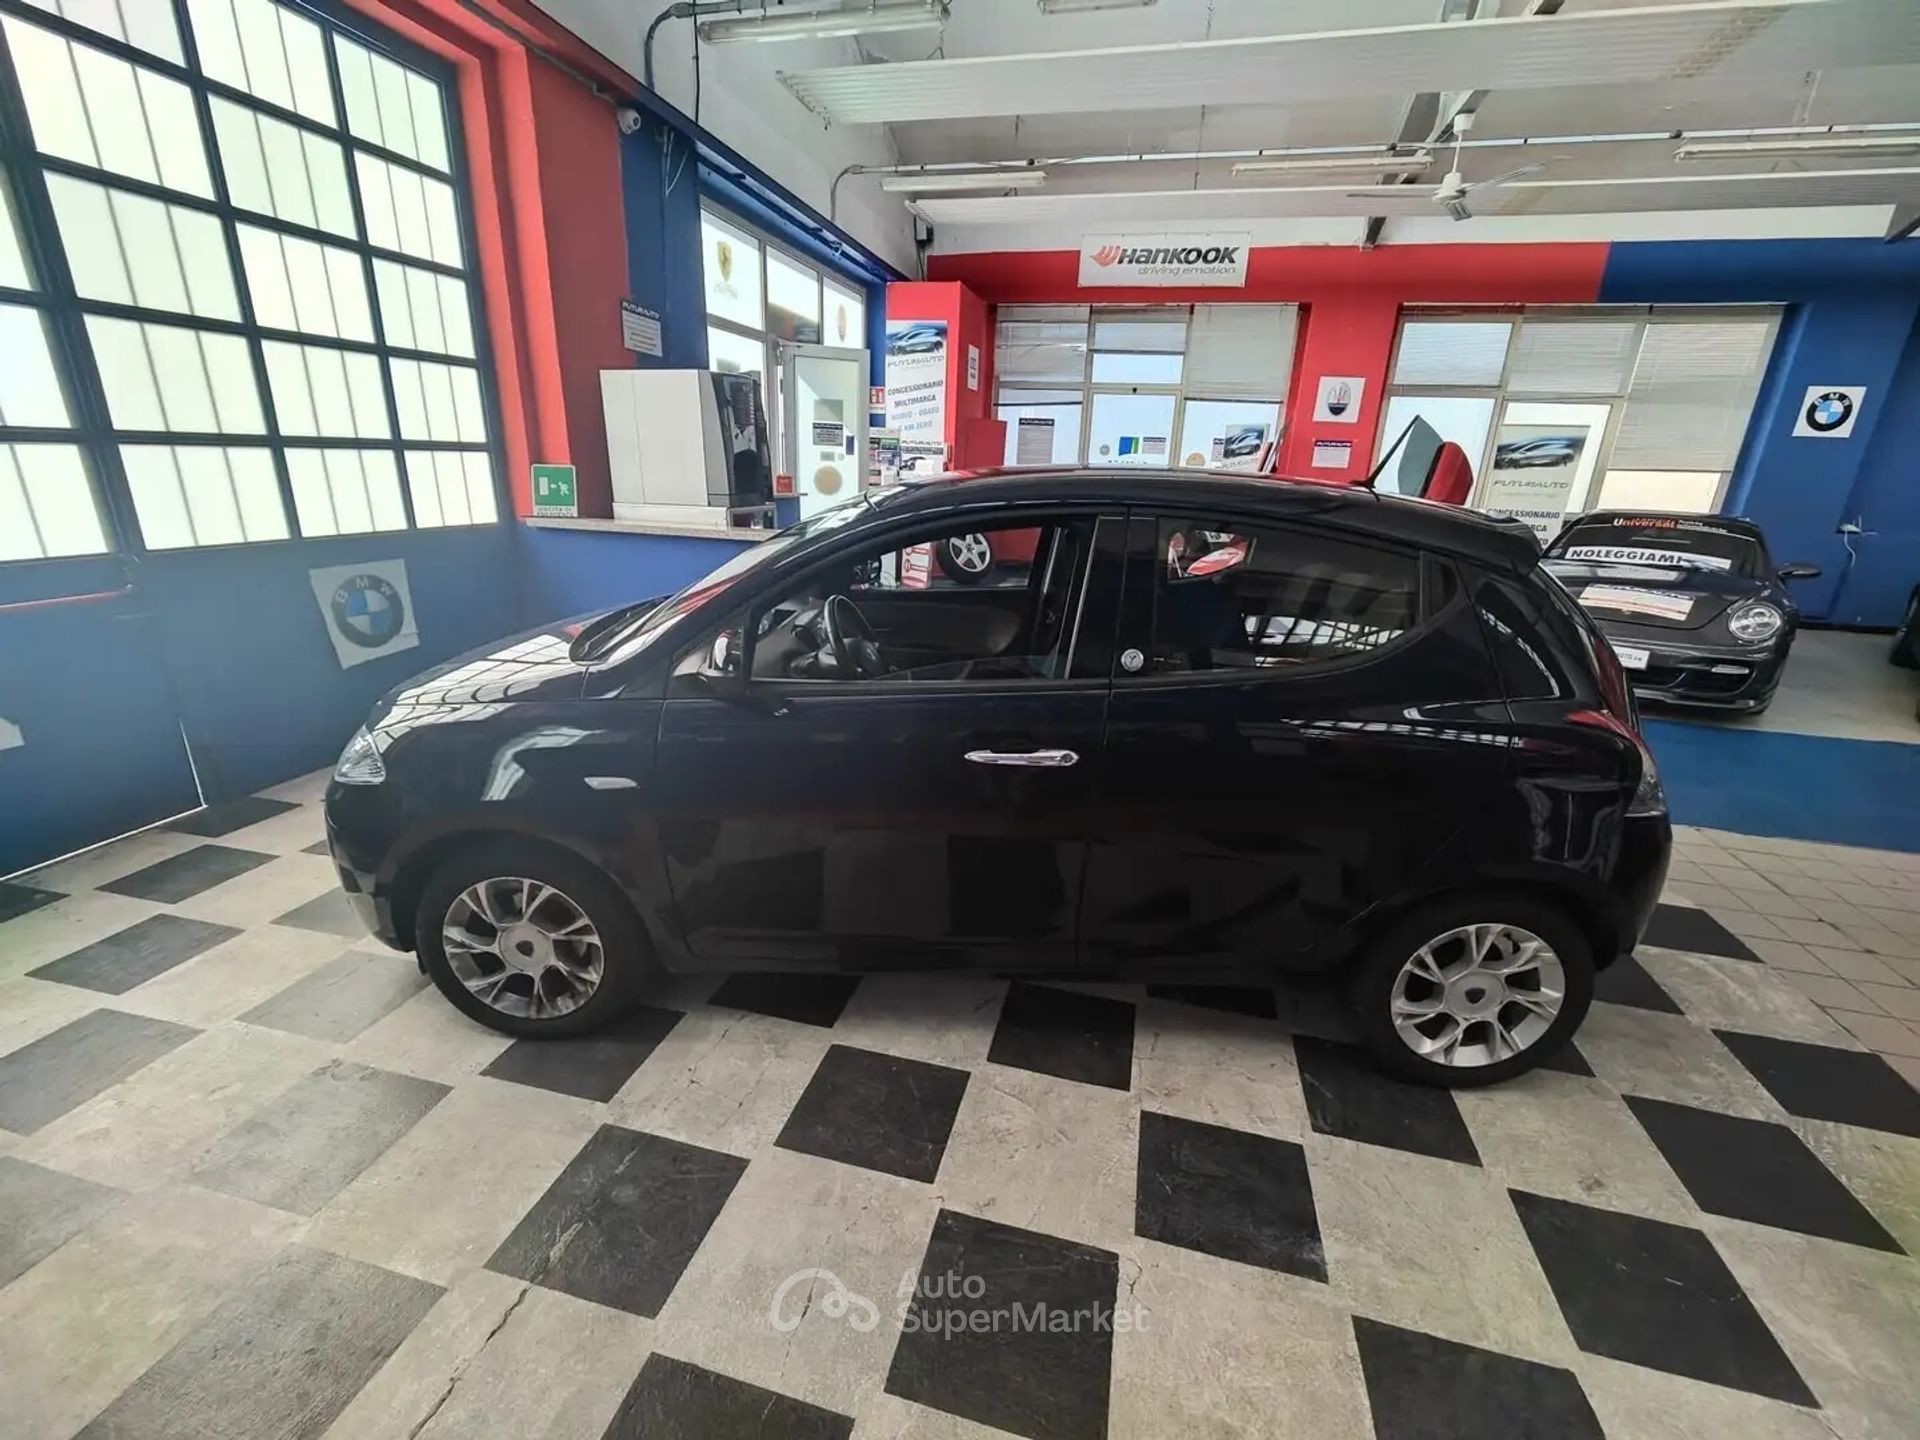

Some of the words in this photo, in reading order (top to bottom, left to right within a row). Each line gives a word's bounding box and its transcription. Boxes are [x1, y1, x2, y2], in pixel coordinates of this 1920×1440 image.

[1138, 265, 1180, 277] driving
[1182, 265, 1236, 275] emotion
[888, 380, 944, 396] CONCESSIONARIO
[894, 394, 937, 408] MULTIMARCA
[1814, 393, 1850, 408] BMW
[336, 575, 393, 604] BMW
